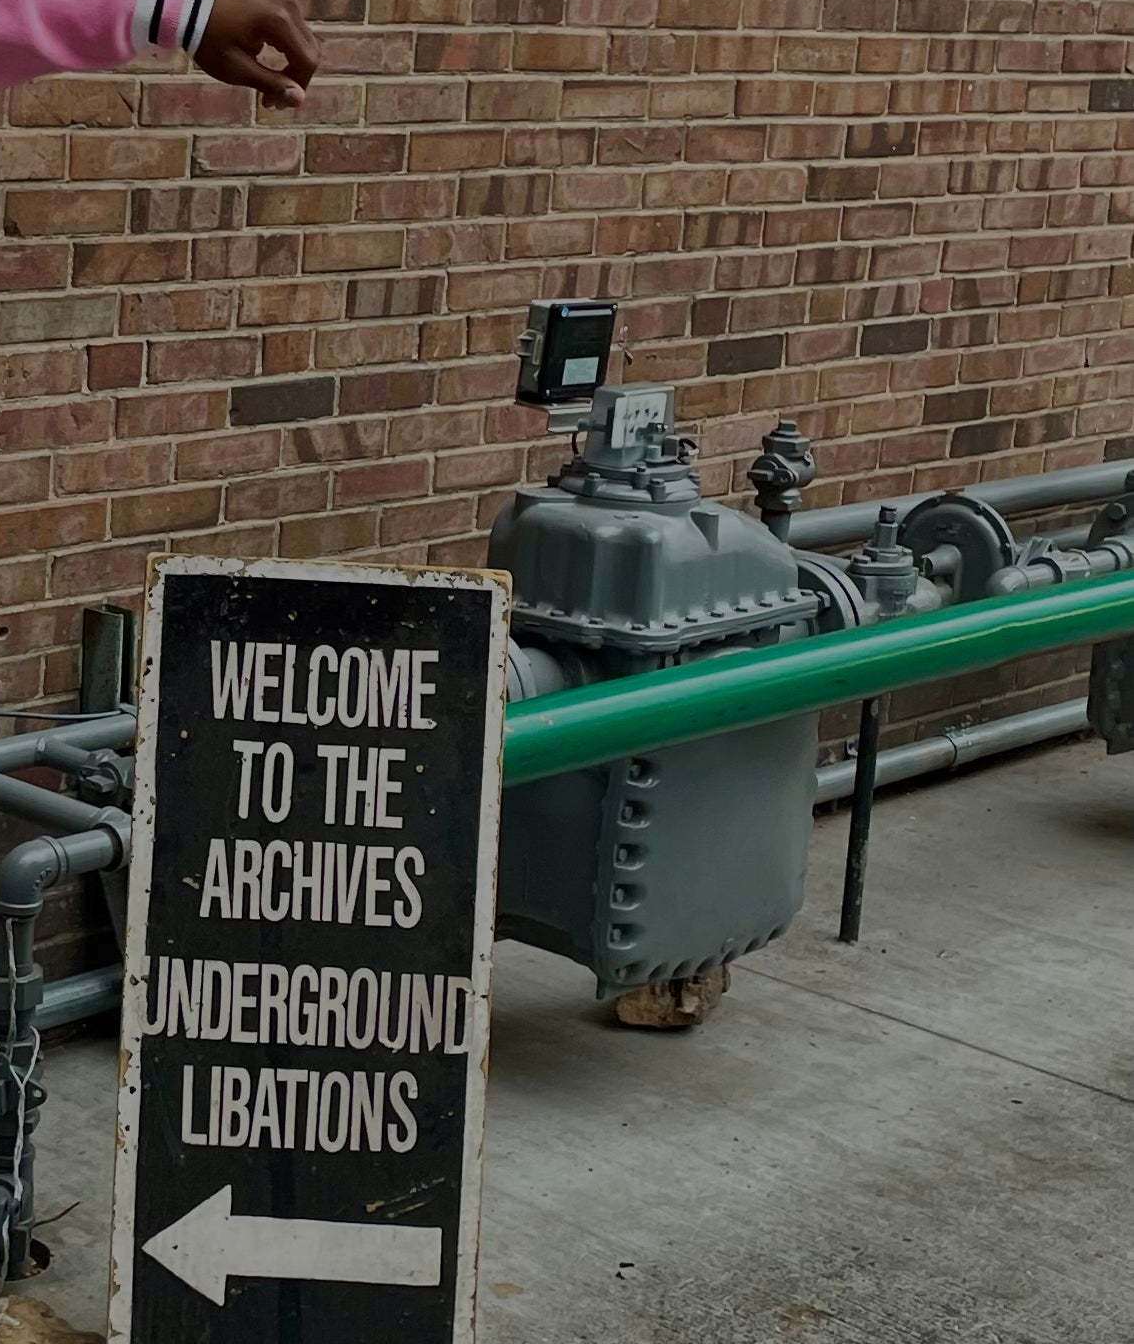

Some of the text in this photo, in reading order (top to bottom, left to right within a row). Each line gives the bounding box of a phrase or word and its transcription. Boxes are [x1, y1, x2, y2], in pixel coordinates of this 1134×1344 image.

[210, 640, 438, 729] WELCOME
[233, 740, 406, 828] TO THE
[199, 838, 425, 929] ARCHIVES
[139, 955, 474, 1055] UNDERGROUND
[181, 1064, 418, 1154] LIBATIONS
